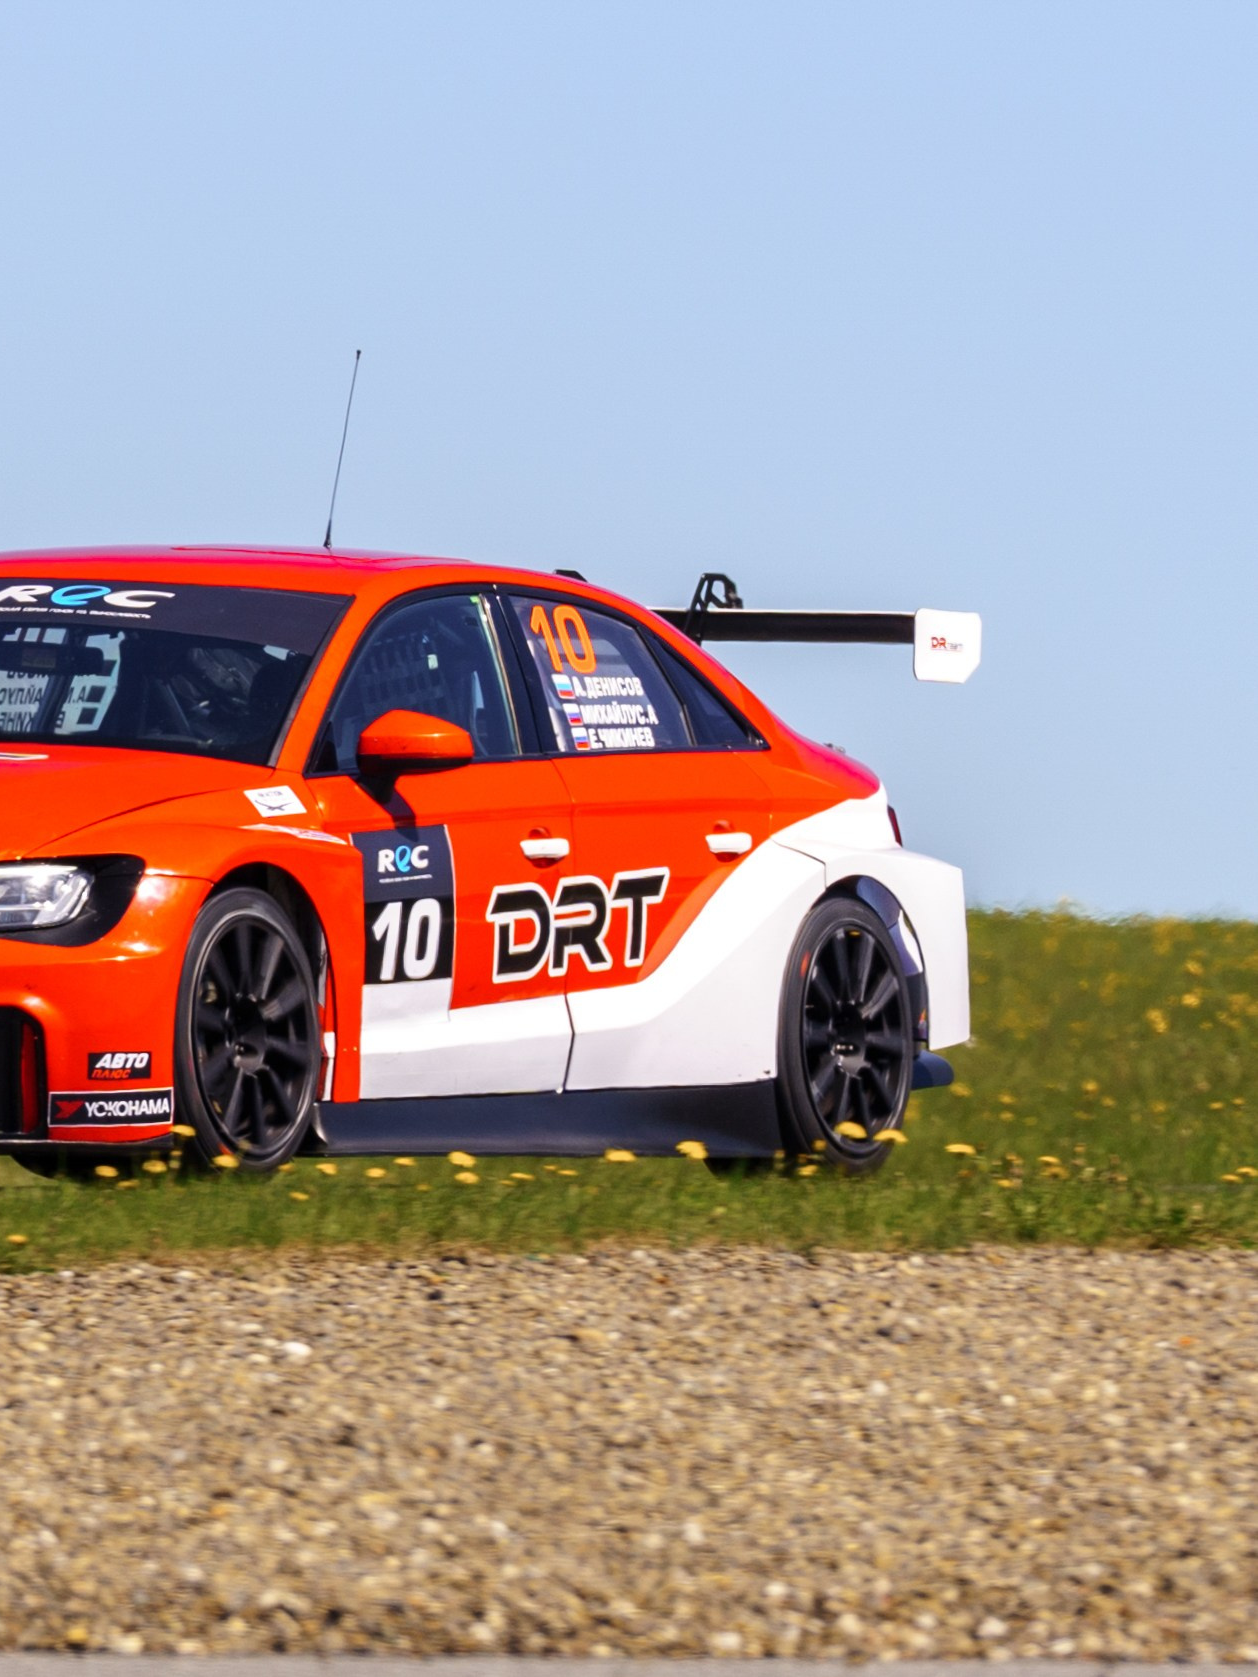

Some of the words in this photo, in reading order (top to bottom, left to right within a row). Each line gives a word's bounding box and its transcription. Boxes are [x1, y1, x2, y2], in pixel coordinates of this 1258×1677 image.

[530, 604, 597, 674] 10
[572, 676, 645, 699] А.ДЕНИСОВ
[579, 701, 659, 725] МИХАЙЛУС.А
[588, 727, 656, 749] Е.ЧИКИНЕВ
[486, 866, 670, 984] DRT
[372, 898, 441, 981] 10
[95, 1052, 150, 1069] АВТО
[91, 1069, 132, 1079] ПЛЮС
[84, 1097, 170, 1118] YOKOHAMA
